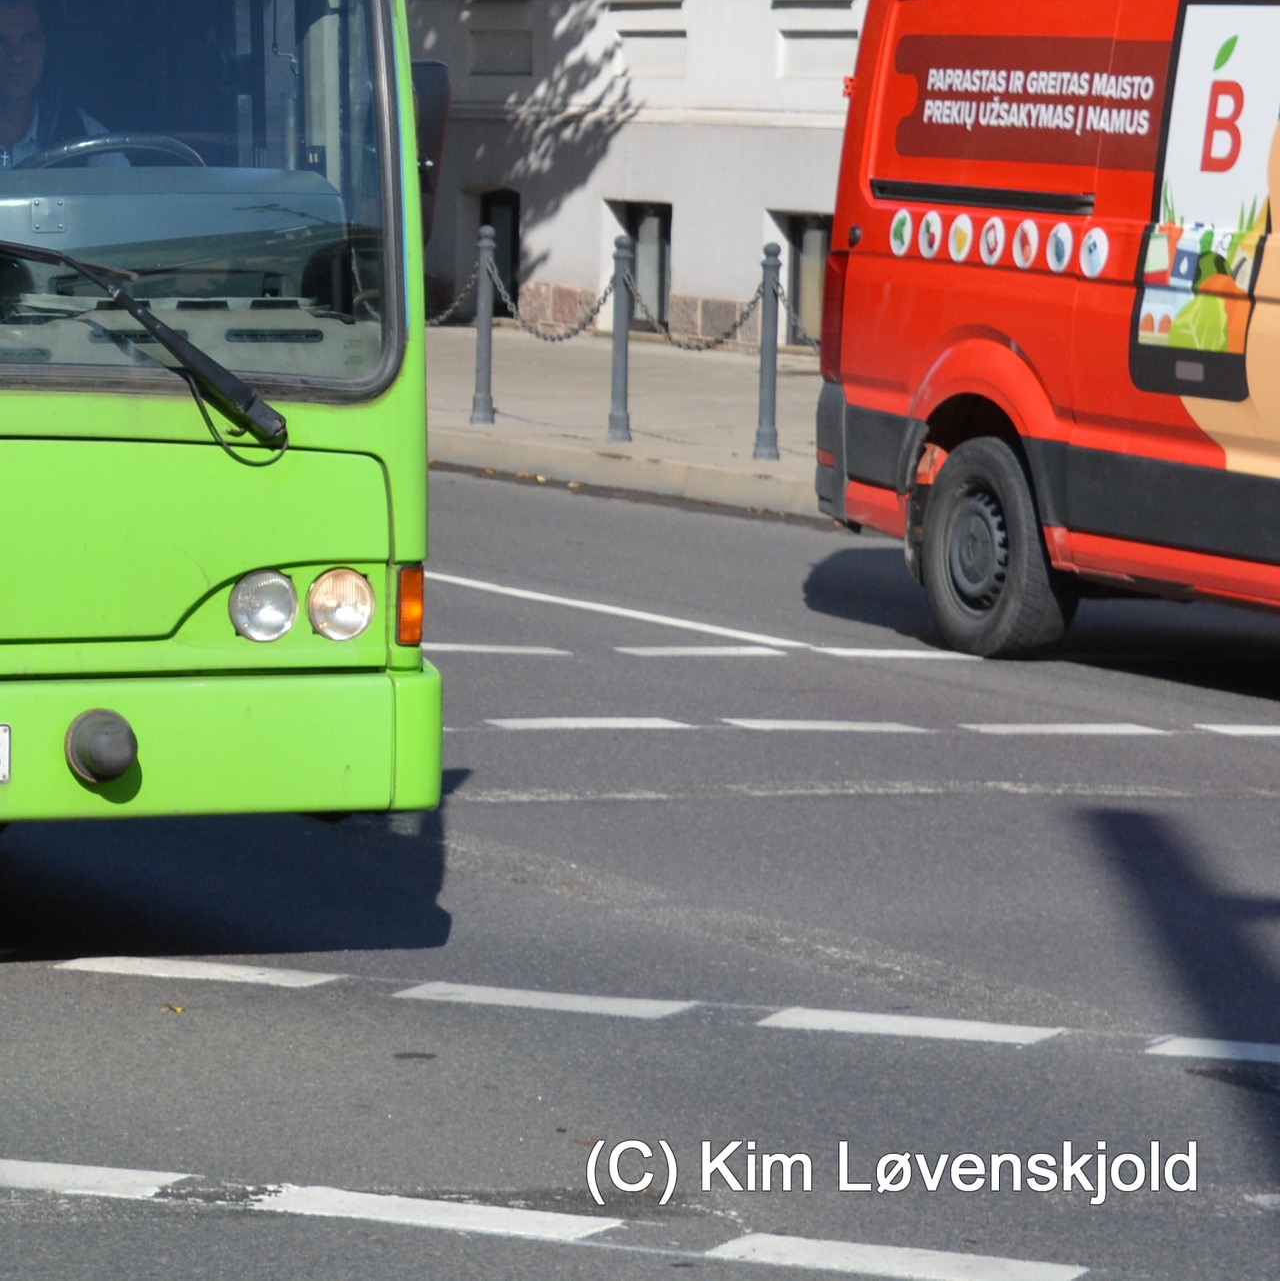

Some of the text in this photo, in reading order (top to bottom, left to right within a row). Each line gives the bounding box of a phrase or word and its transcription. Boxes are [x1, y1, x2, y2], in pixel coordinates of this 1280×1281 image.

[927, 68, 1154, 100] PAPRASTAS IR GREITAS MAISTO
[923, 99, 977, 131] PREKIŲ
[978, 95, 1075, 131] UŽSAKYMAS
[1085, 106, 1150, 135] NAMUS
[1200, 79, 1245, 174] B
